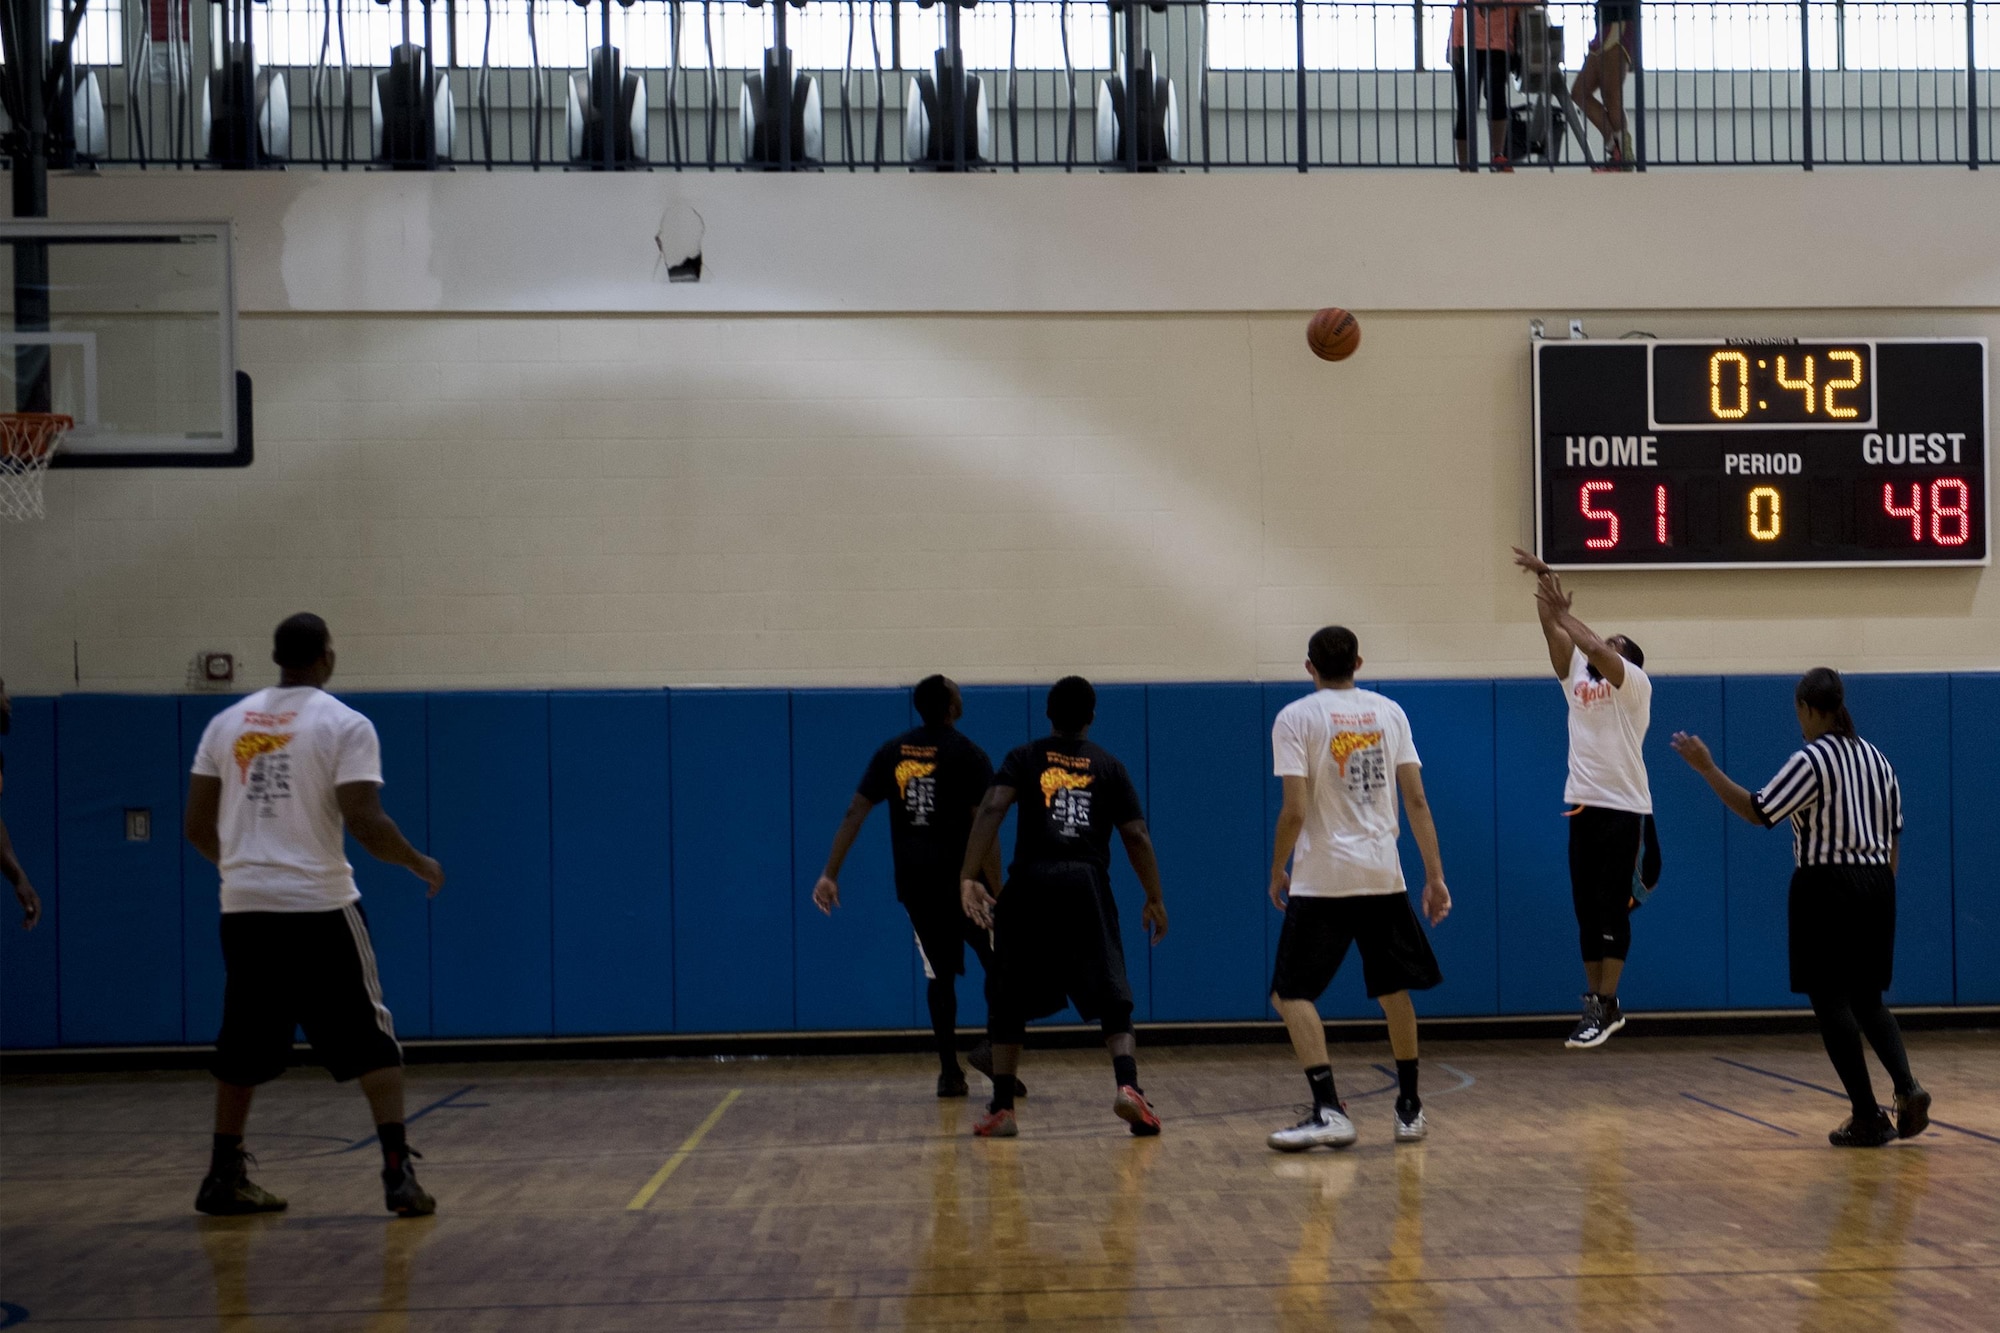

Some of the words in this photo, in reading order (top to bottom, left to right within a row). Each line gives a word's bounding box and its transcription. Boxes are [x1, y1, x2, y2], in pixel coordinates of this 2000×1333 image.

[1709, 350, 1862, 419] 0:42
[1565, 435, 1659, 467] HOME
[1724, 452, 1803, 475] PERIOD
[1862, 432, 1966, 465] GUEST
[1579, 480, 1667, 549] 51
[1747, 486, 1781, 542] 0
[1883, 477, 1970, 546] 48
